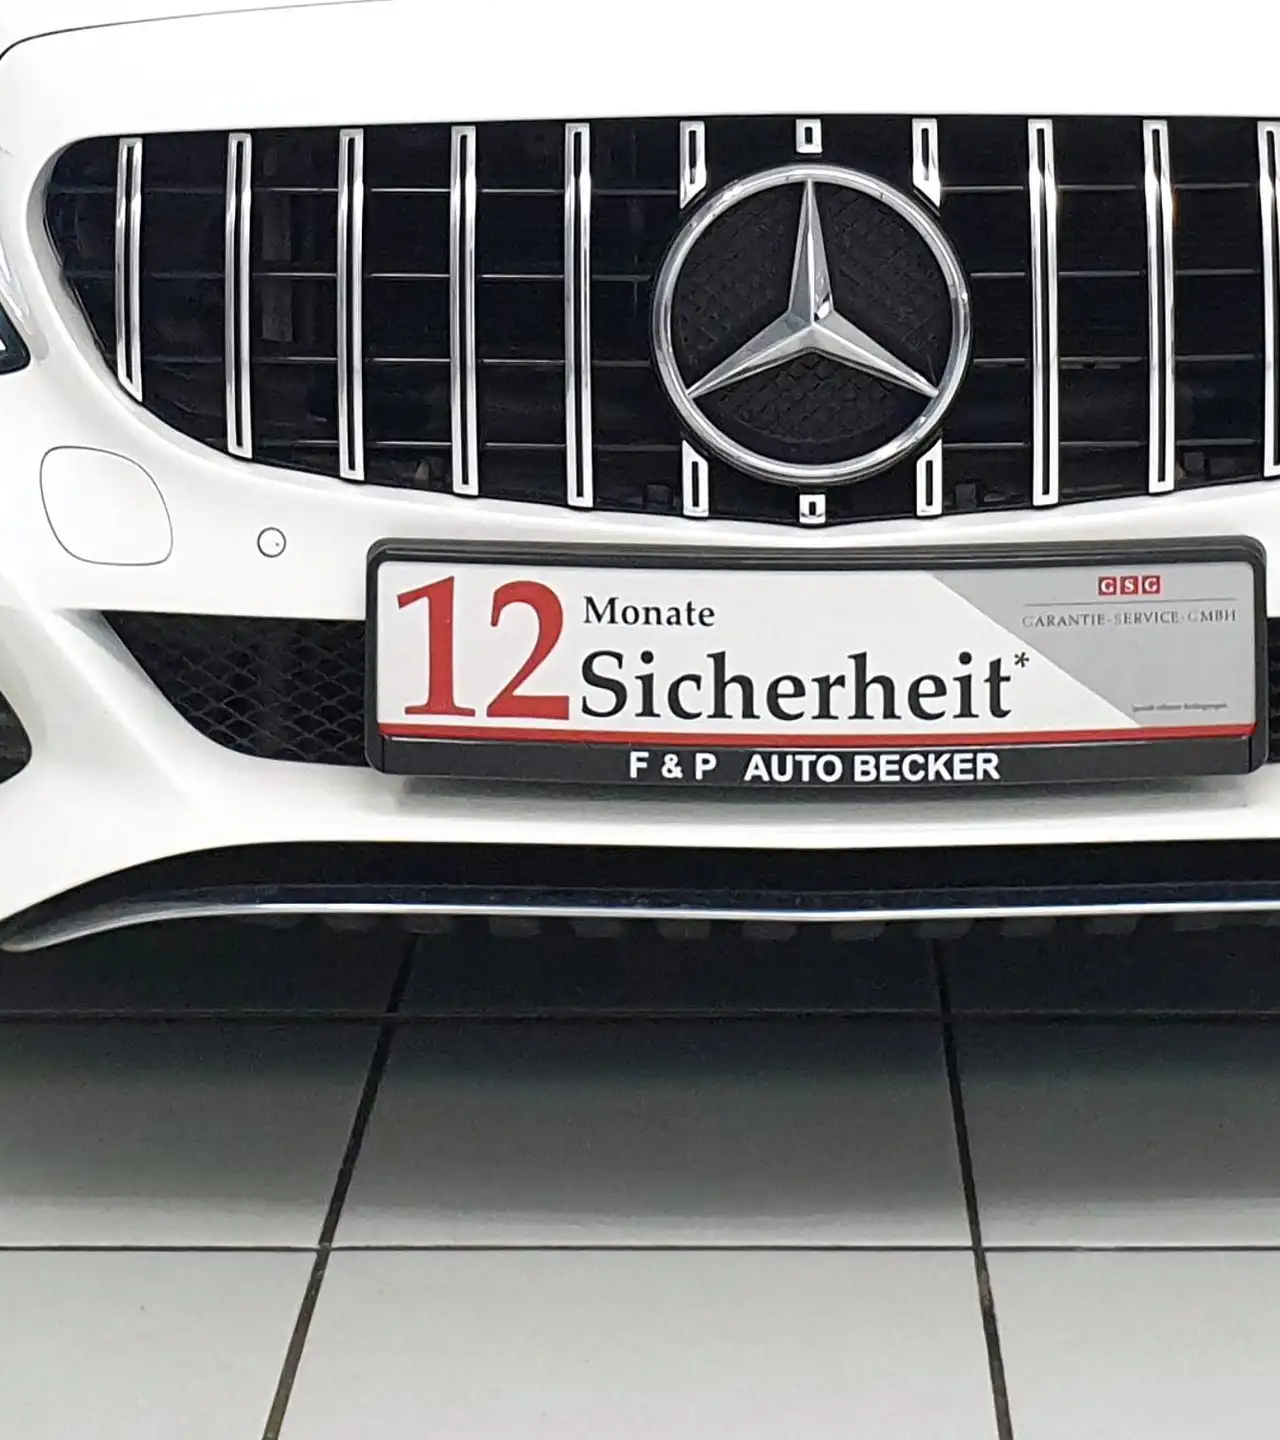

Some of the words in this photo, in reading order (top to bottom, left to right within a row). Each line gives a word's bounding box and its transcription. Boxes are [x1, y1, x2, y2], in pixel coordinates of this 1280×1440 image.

[1099, 576, 1160, 595] GSG
[583, 595, 716, 628] Monate
[396, 575, 571, 721] 12
[629, 751, 649, 779] F
[660, 751, 684, 779] &
[695, 751, 718, 780] P
[744, 752, 843, 782] AUTO
[853, 751, 1001, 782] BECKER
